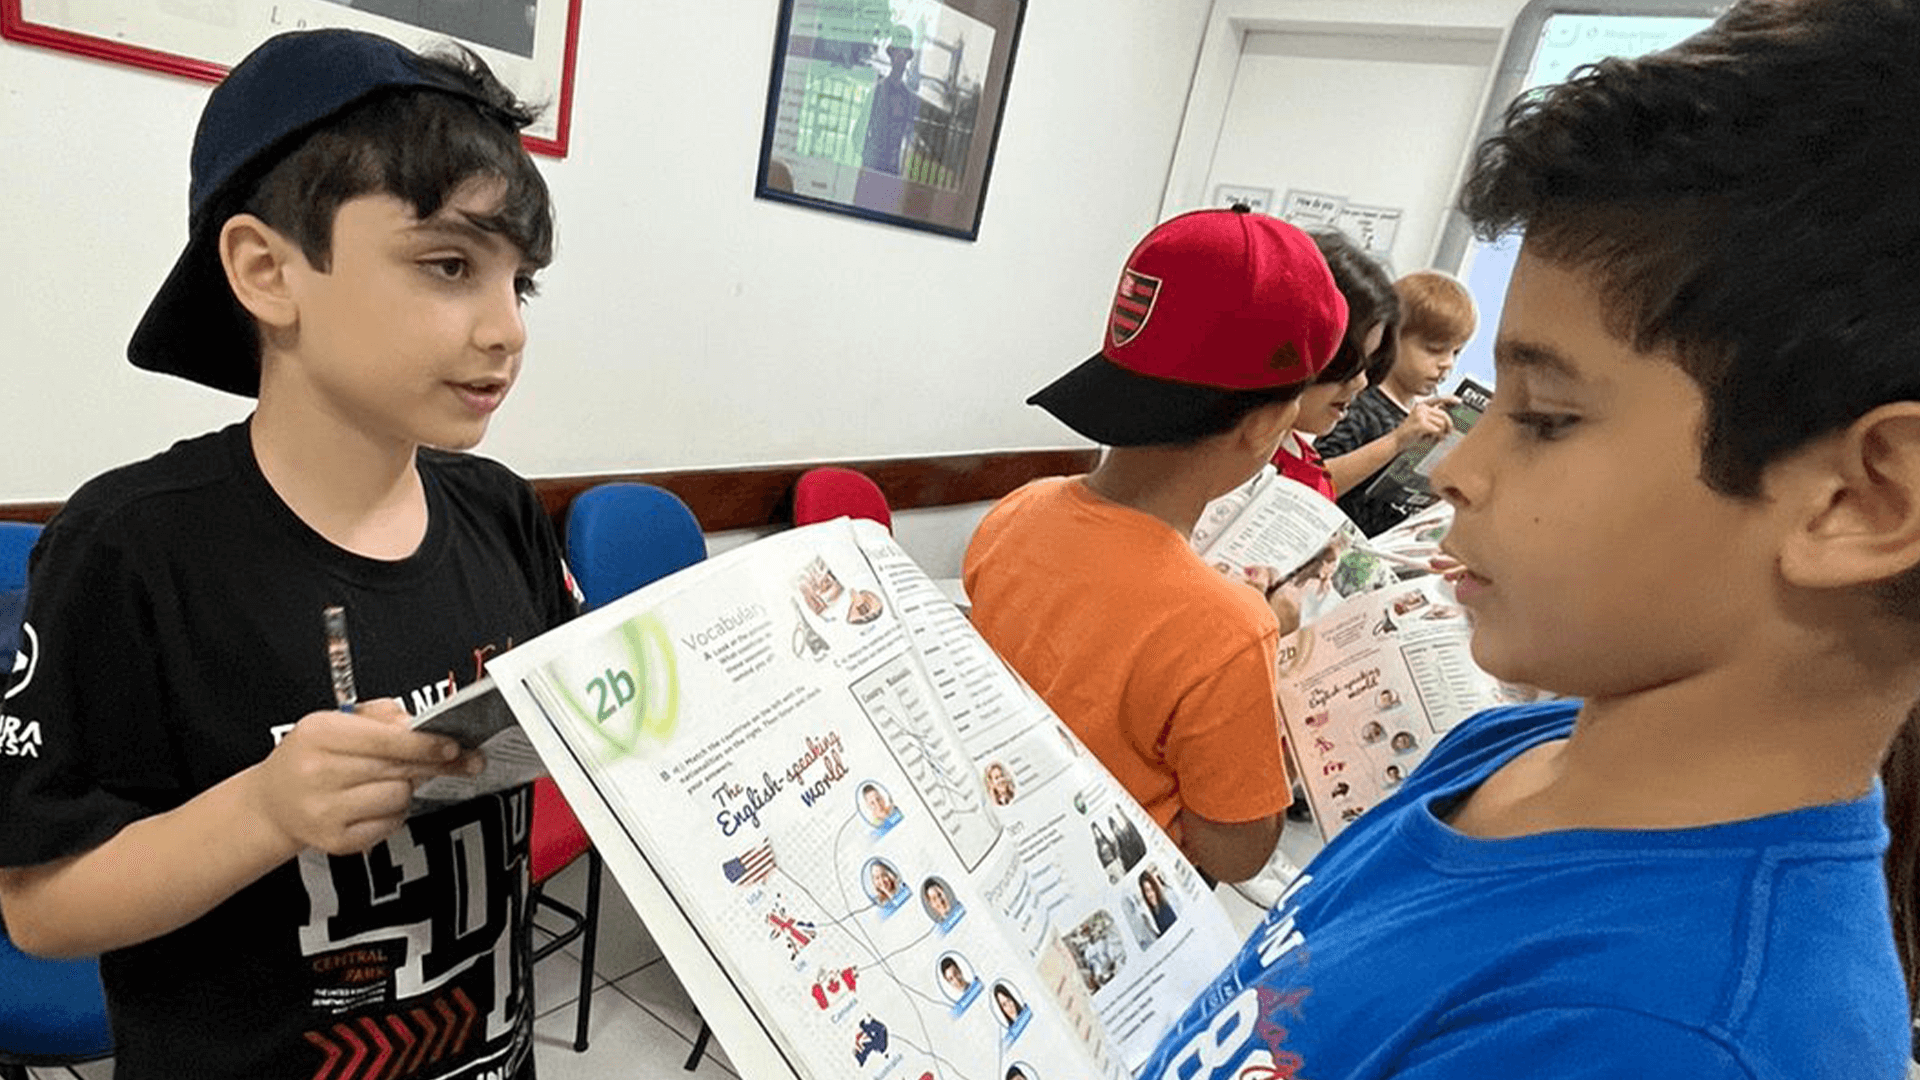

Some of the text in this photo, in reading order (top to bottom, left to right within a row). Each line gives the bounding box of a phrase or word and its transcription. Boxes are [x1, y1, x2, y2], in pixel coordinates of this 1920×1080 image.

[586, 668, 635, 723] 2b
[712, 782, 744, 807] The
[717, 731, 844, 837] English-speaking
[800, 748, 850, 807] world
[312, 949, 388, 972] CENTRAL
